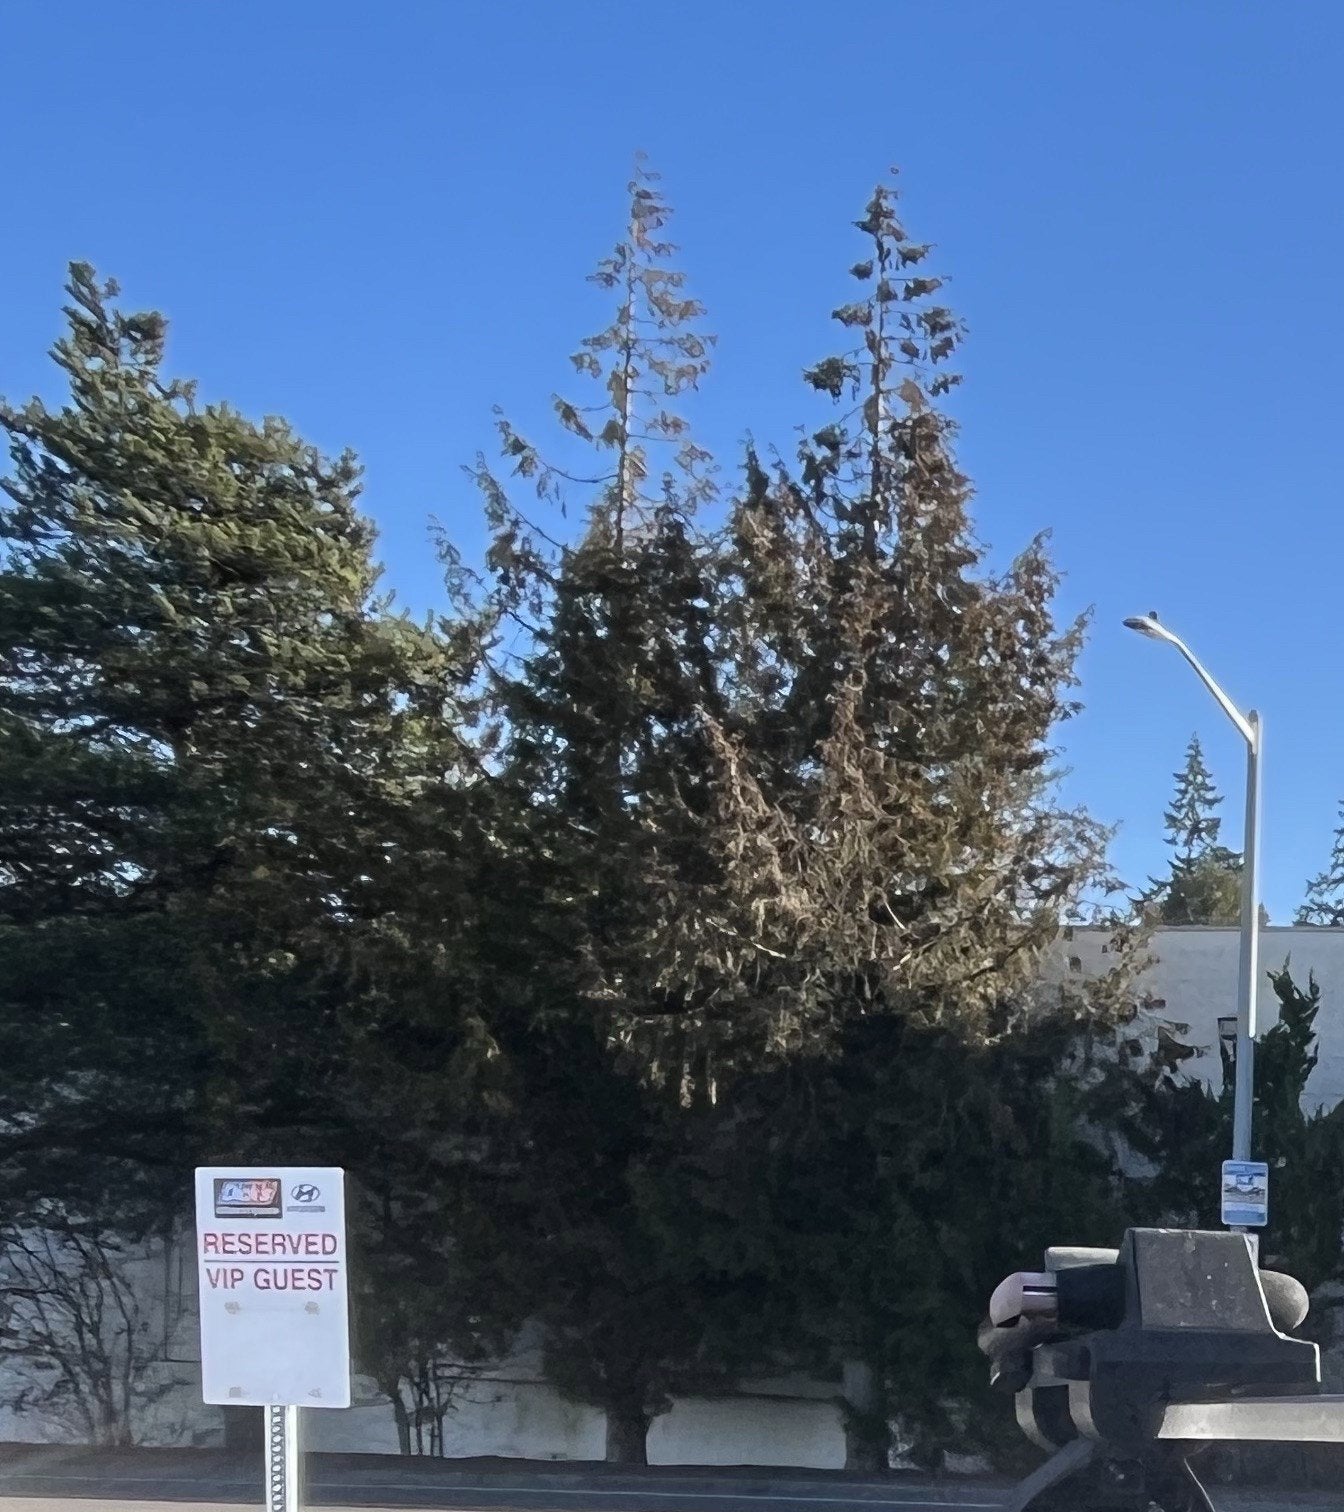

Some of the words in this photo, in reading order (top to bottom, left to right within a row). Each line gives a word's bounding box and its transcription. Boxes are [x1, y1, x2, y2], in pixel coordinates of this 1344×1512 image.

[203, 1232, 338, 1256] RESERVED
[205, 1268, 245, 1290] VIP
[253, 1268, 339, 1291] GUEST
